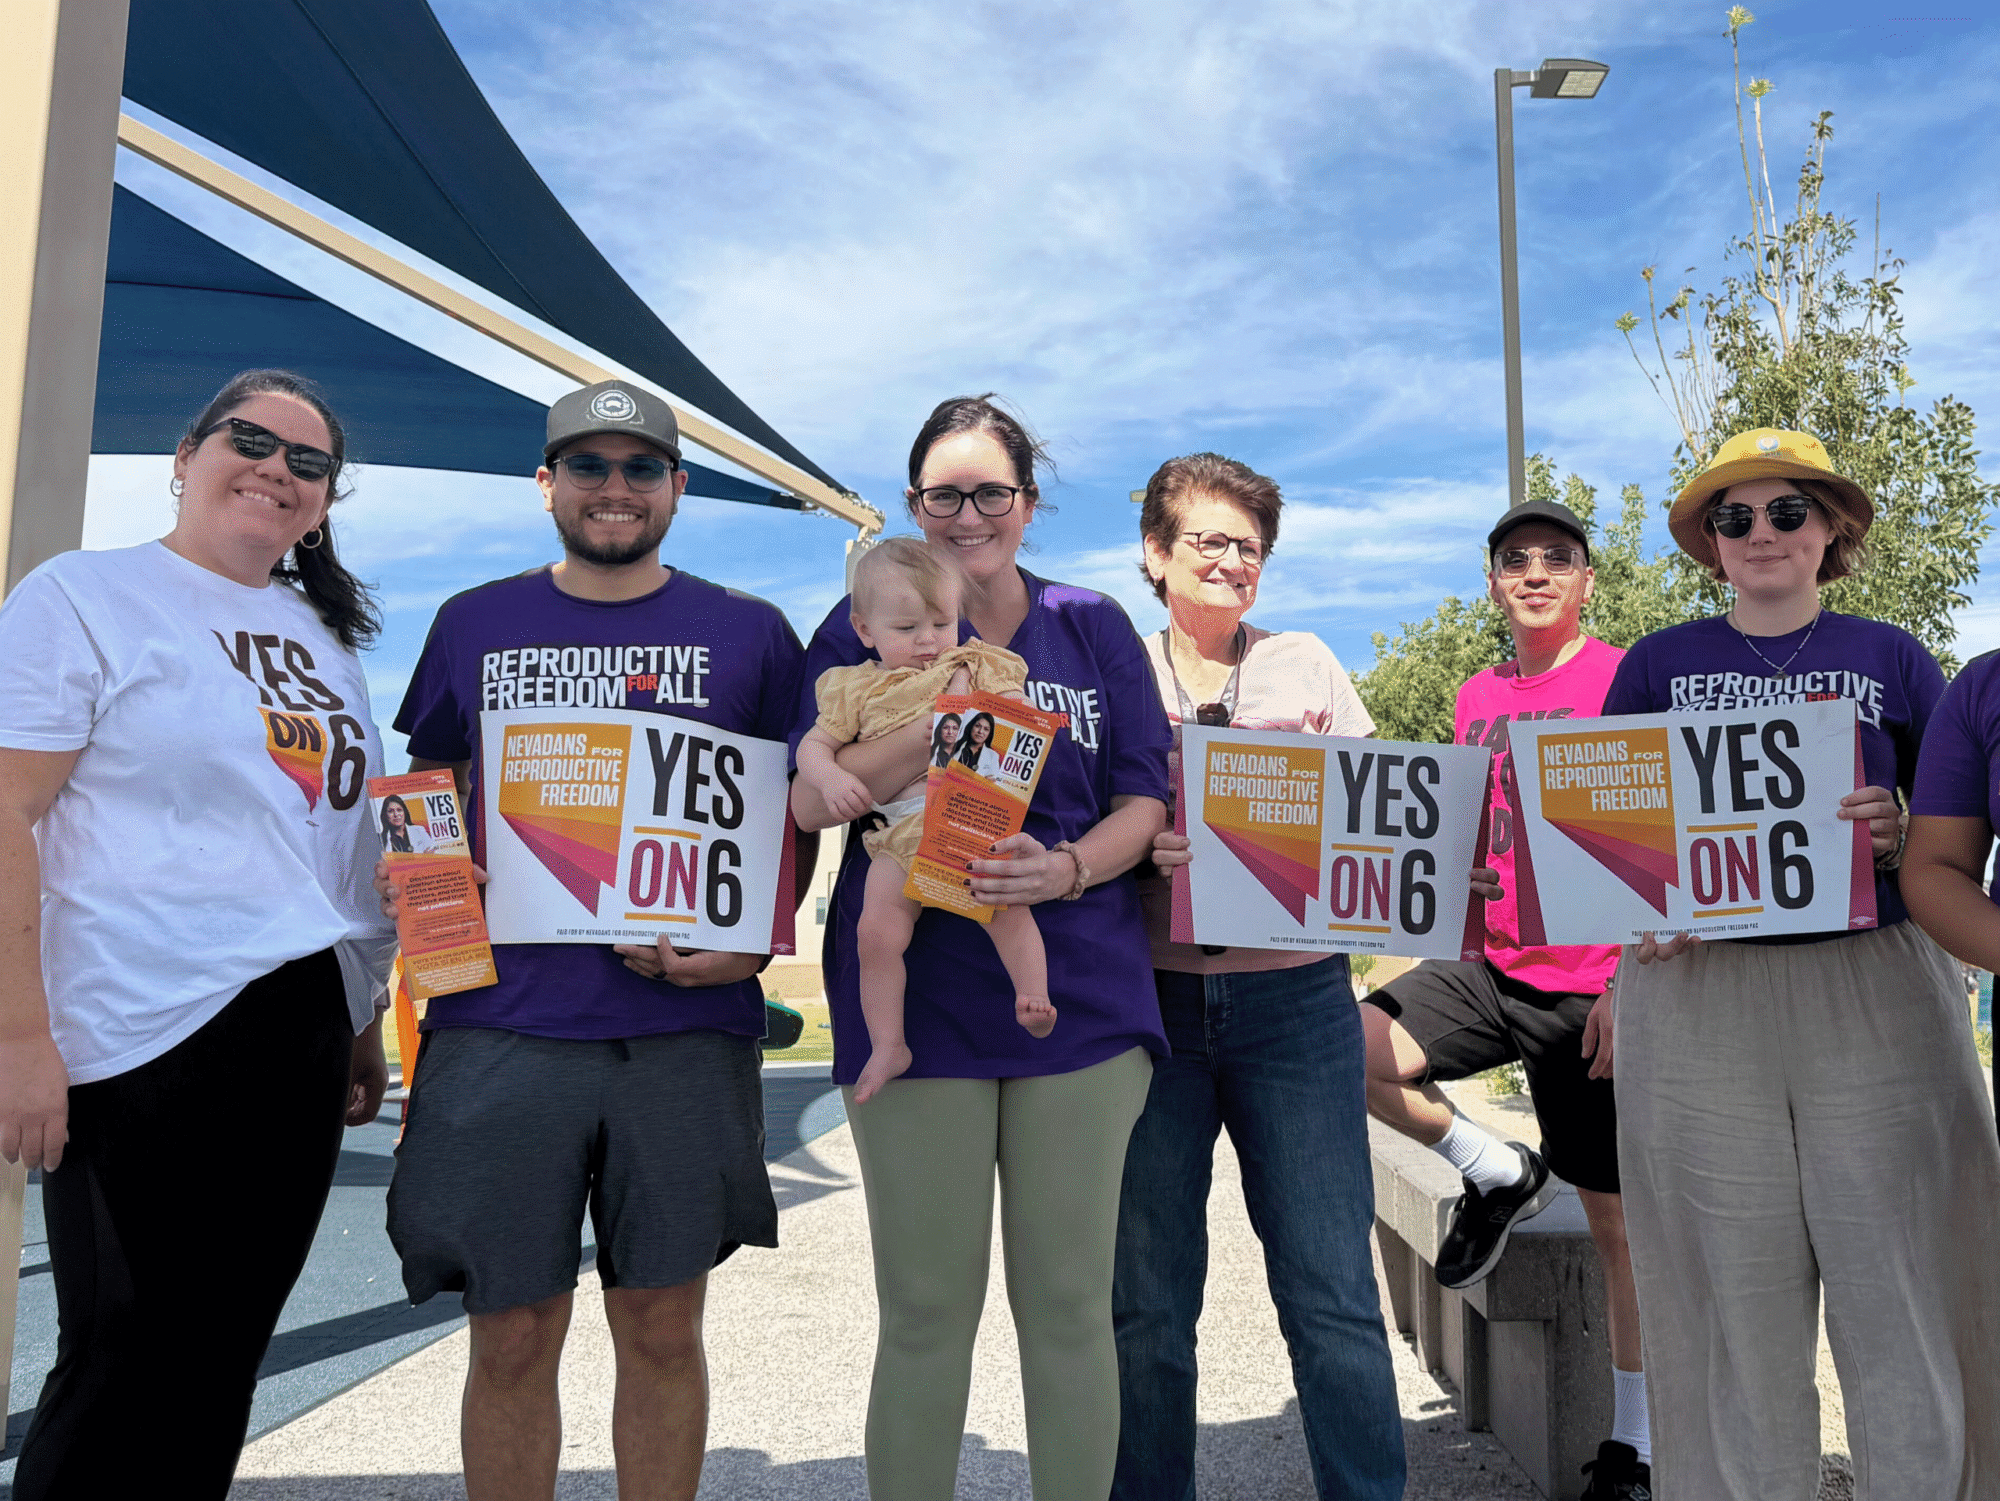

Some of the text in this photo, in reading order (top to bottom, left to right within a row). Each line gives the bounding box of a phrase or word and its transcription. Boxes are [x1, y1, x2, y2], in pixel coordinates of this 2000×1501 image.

[210, 629, 345, 711] YES
[483, 646, 710, 682] REPRODUCTIVE
[482, 674, 710, 711] FREEDOM FOR ALL
[1670, 670, 1884, 712] REPRODUCTIVE
[507, 734, 623, 758] NEVADANS FOR
[1013, 731, 1043, 759] YES
[1543, 741, 1663, 766] NEVADANS FOR
[269, 712, 366, 811] ON 6
[505, 759, 622, 783] REPRODUCTIVE
[1004, 756, 1034, 781] ON 6
[1210, 752, 1319, 779] NEVADANS FOR
[1680, 719, 1805, 814] YES
[646, 728, 745, 830] YES
[1209, 775, 1319, 803] REPRODUCTIVE
[1545, 763, 1665, 790] REPRODUCTIVE
[426, 794, 455, 817] YES
[540, 784, 619, 807] FREEDOM
[1337, 751, 1440, 839] YES
[1591, 786, 1668, 812] FREEDOM
[432, 817, 460, 838] ON 6
[1248, 804, 1318, 826] FREEDOM
[1689, 820, 1814, 910] ON 6
[628, 839, 743, 928] ON 6
[1330, 849, 1436, 935] ON 6
[622, 930, 658, 938] REPRODUCTIVE
